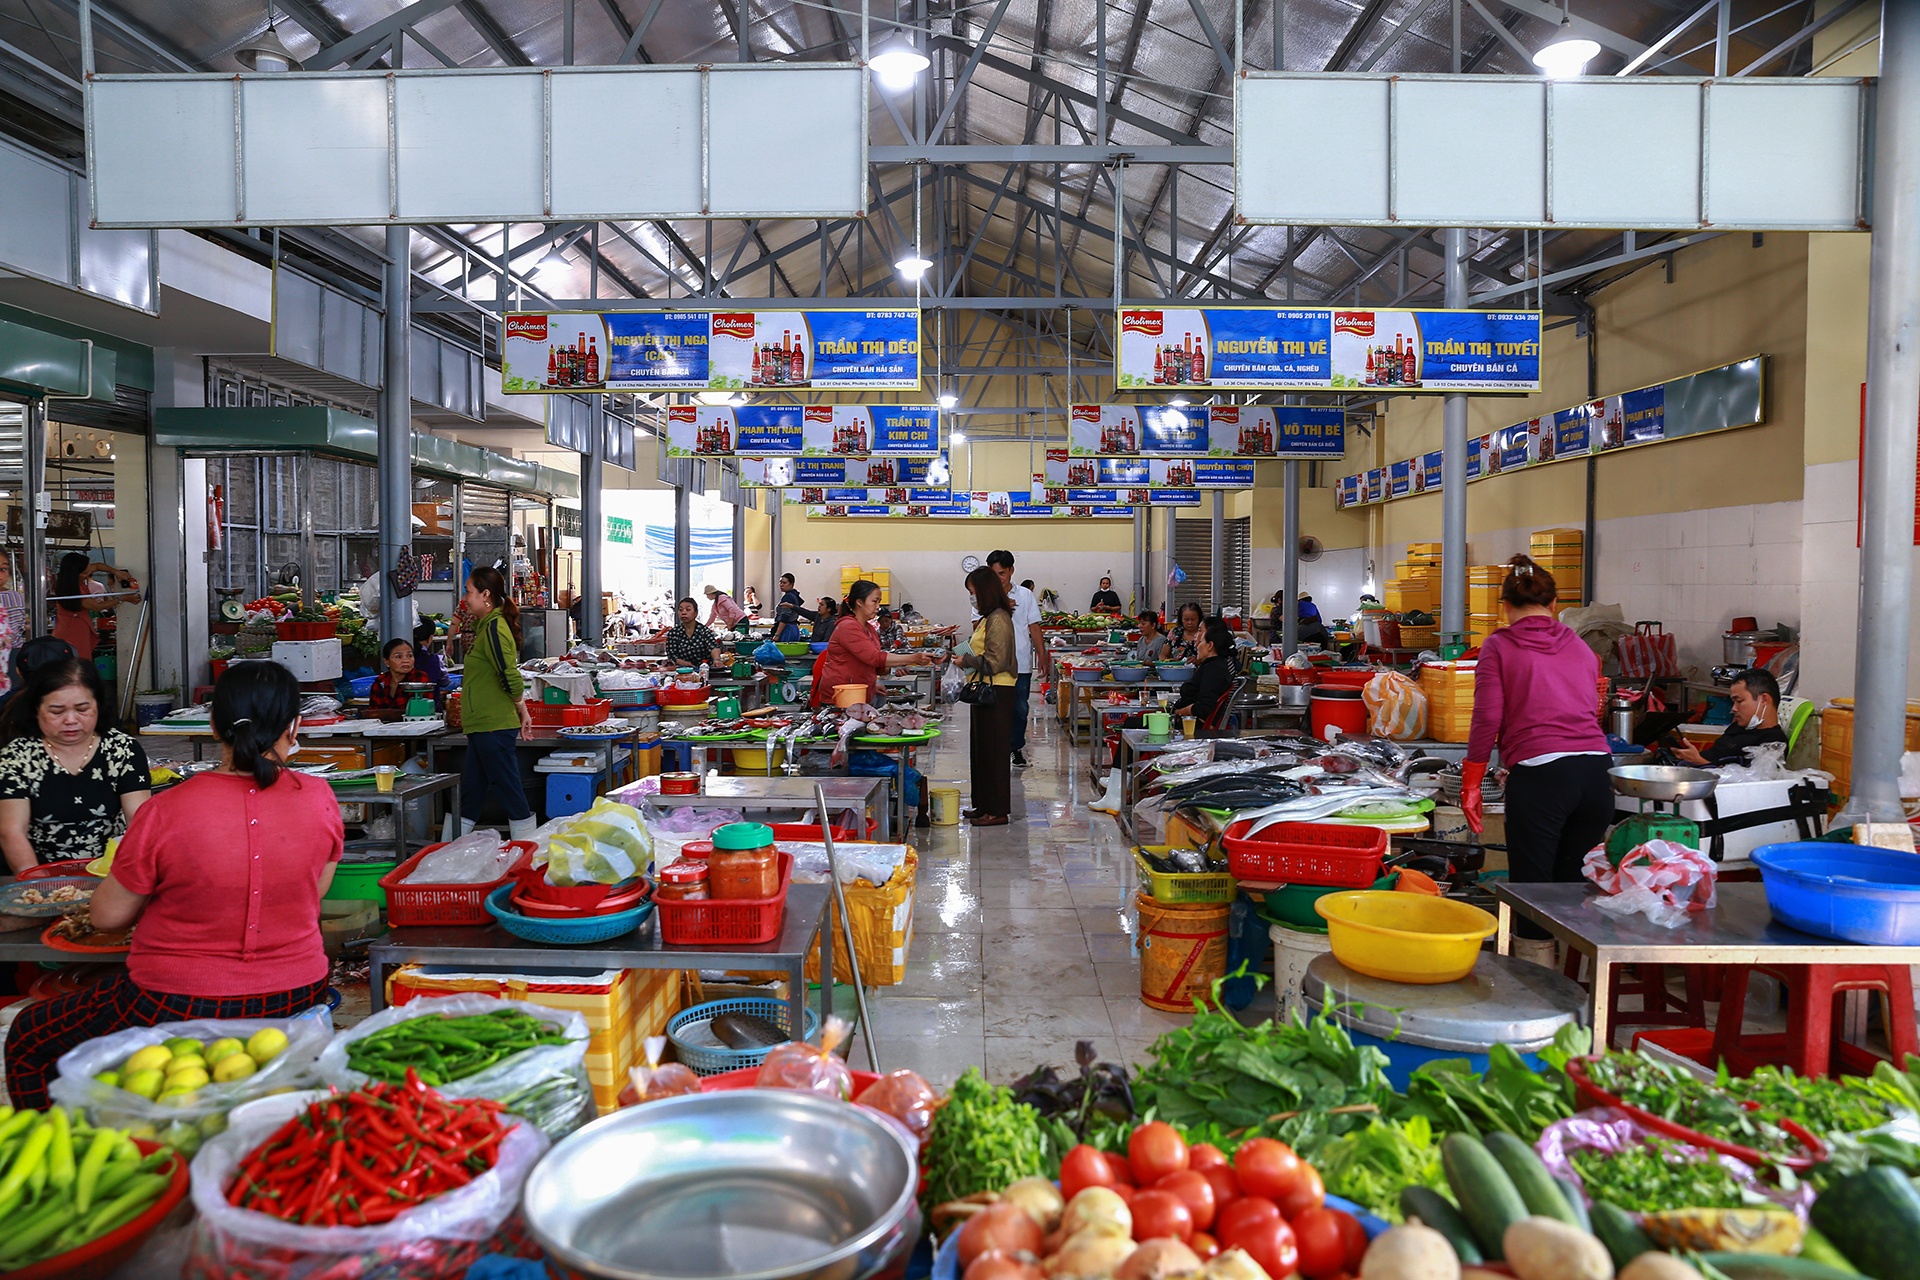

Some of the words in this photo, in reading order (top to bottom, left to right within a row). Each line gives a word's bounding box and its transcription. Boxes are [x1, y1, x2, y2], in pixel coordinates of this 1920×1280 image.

[508, 320, 547, 331] Cholimex
[714, 318, 754, 328] Cholimex
[1123, 316, 1162, 326] Cholimex
[1336, 316, 1374, 326] Cholimex
[614, 332, 660, 346] NGUYỄN
[663, 336, 680, 348] THỊ
[684, 336, 708, 345] NGA
[818, 337, 858, 354] TRẦN
[862, 341, 884, 356] THỊ
[1218, 336, 1278, 354] NGUYỄN
[1282, 342, 1304, 357] THỊ
[1426, 338, 1464, 354] TRẦN
[1468, 342, 1492, 358] THỊ
[1496, 339, 1538, 356] TUYẾT
[1450, 363, 1484, 372] CHUYÊN
[1486, 363, 1504, 372] BÁN
[1506, 363, 1518, 372] CÁ
[914, 418, 930, 429] THỊ
[766, 426, 780, 436] THỊ
[888, 431, 908, 440] KIM
[910, 431, 928, 440] CHI
[1302, 425, 1322, 438] THỊ
[1325, 423, 1340, 436] BÉ
